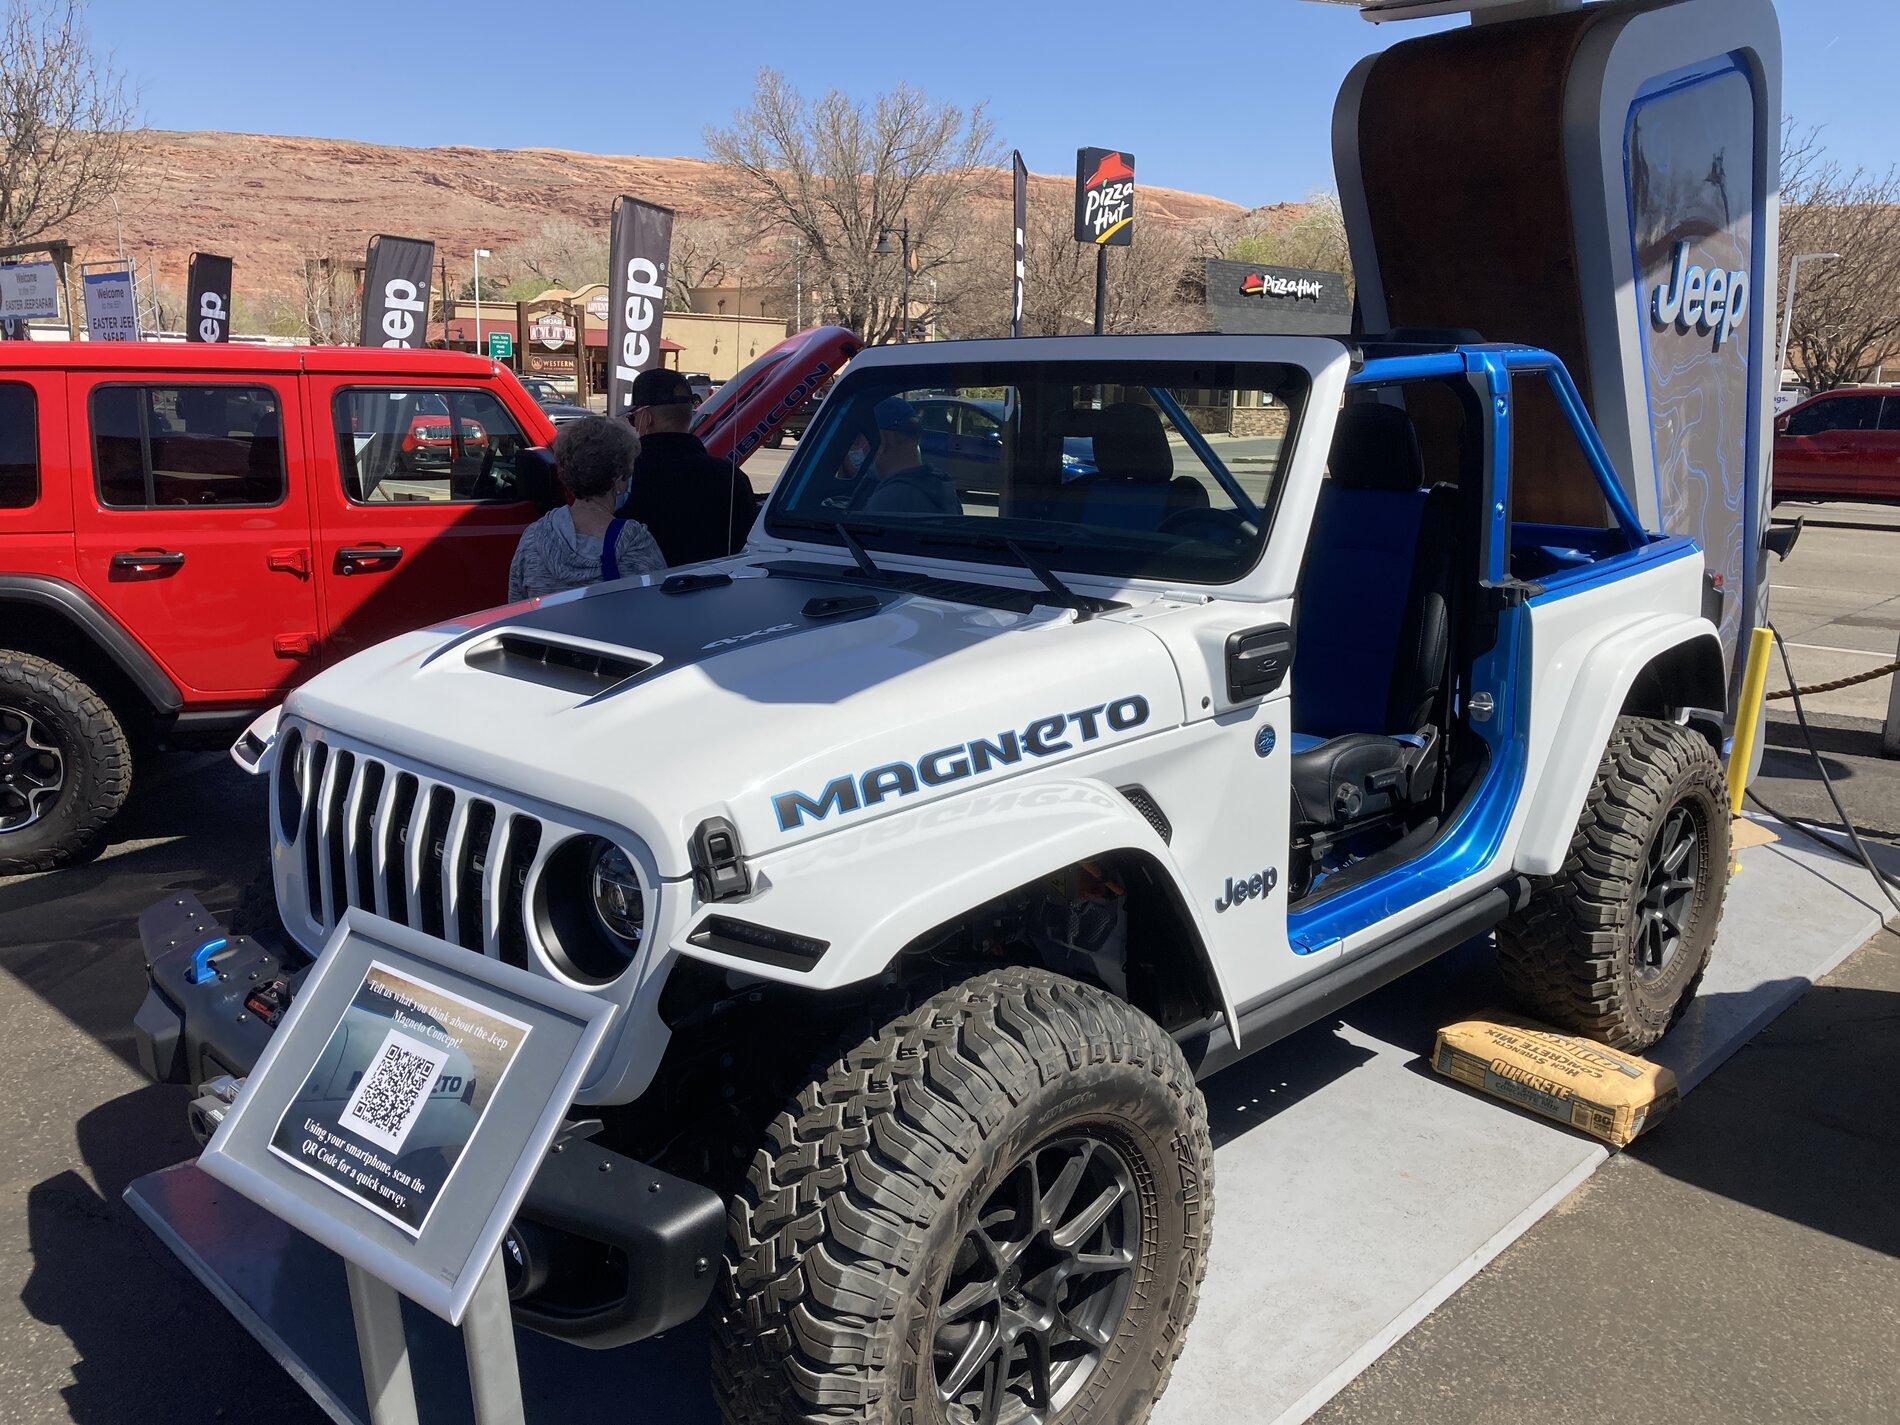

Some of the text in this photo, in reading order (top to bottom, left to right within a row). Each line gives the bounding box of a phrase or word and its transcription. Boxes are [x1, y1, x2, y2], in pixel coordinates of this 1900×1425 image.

[1085, 180, 1133, 225] Pizza
[1094, 200, 1130, 235] Hut
[96, 288, 125, 299] Welcome
[1653, 242, 1748, 342] Jeep
[93, 317, 118, 329] EASTER
[103, 332, 127, 342] SAFARI
[543, 360, 574, 368] WESTERN
[727, 361, 832, 465] BICON
[1215, 866, 1277, 913] Jeep
[369, 979, 383, 995] Tell
[393, 988, 413, 1008] what
[410, 1000, 427, 1014] you
[427, 1003, 450, 1023] think
[449, 1014, 475, 1034] about
[474, 1023, 488, 1041] the
[487, 1030, 508, 1051] Jeep
[391, 1009, 464, 1049] Magneto Concept!
[1485, 1029, 1518, 1047] MIX
[1492, 1039, 1549, 1065] STRENGTH
[1490, 1058, 1573, 1101] QUIKRETE
[1520, 1042, 1603, 1079] CONCRETE
[1552, 1062, 1580, 1077] HIGH
[302, 1139, 406, 1208] QR Code for a quick survey.
[303, 1117, 426, 1194] Using your smartphone, scan the
